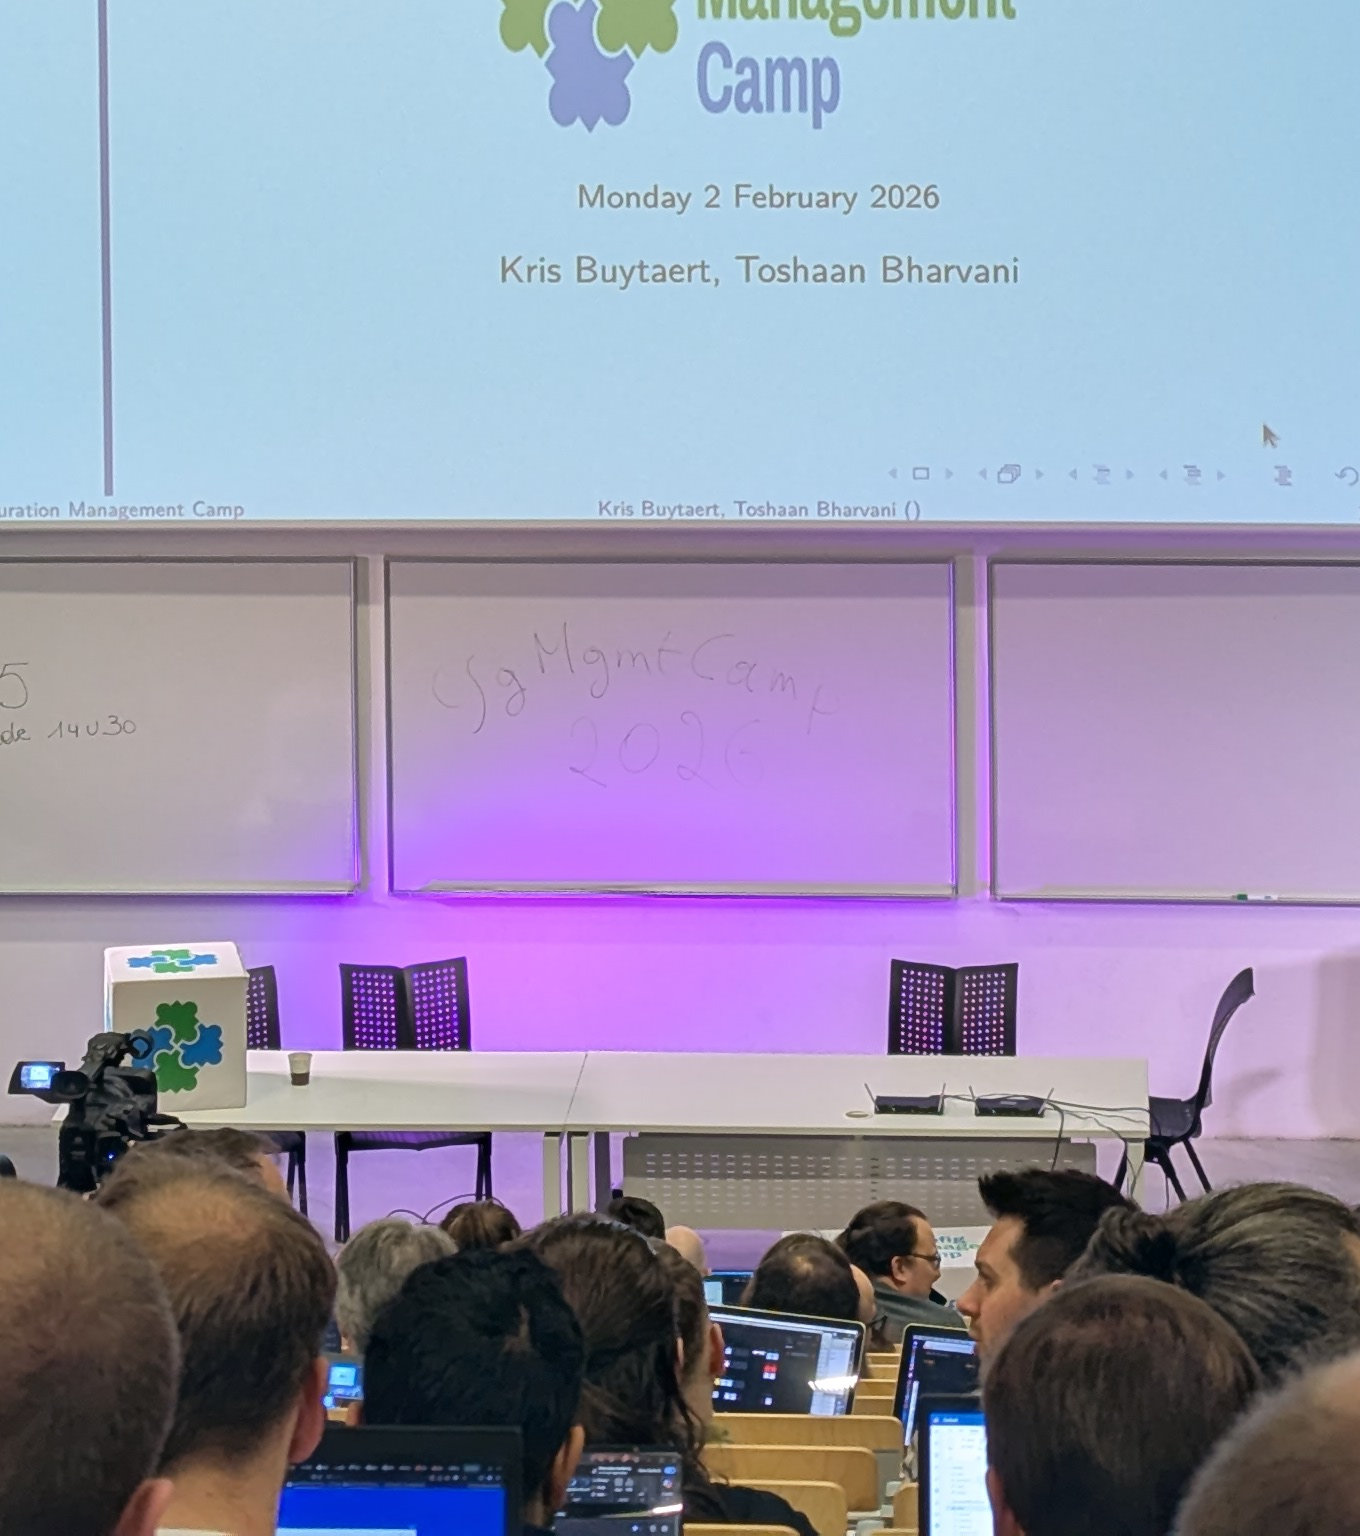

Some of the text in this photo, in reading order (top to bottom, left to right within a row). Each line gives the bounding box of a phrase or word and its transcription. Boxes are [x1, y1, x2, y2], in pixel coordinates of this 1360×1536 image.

[696, 40, 842, 130] Camp
[578, 183, 940, 216] Monday 2 February 2026
[500, 255, 1019, 291] Kris Buytaert, Toshaan Bharvani
[68, 501, 185, 520] Management
[192, 500, 245, 520] Camp
[598, 500, 921, 521] Kris Buytaert, Toshaan Bharvani ()
[568, 709, 765, 792] 2026
